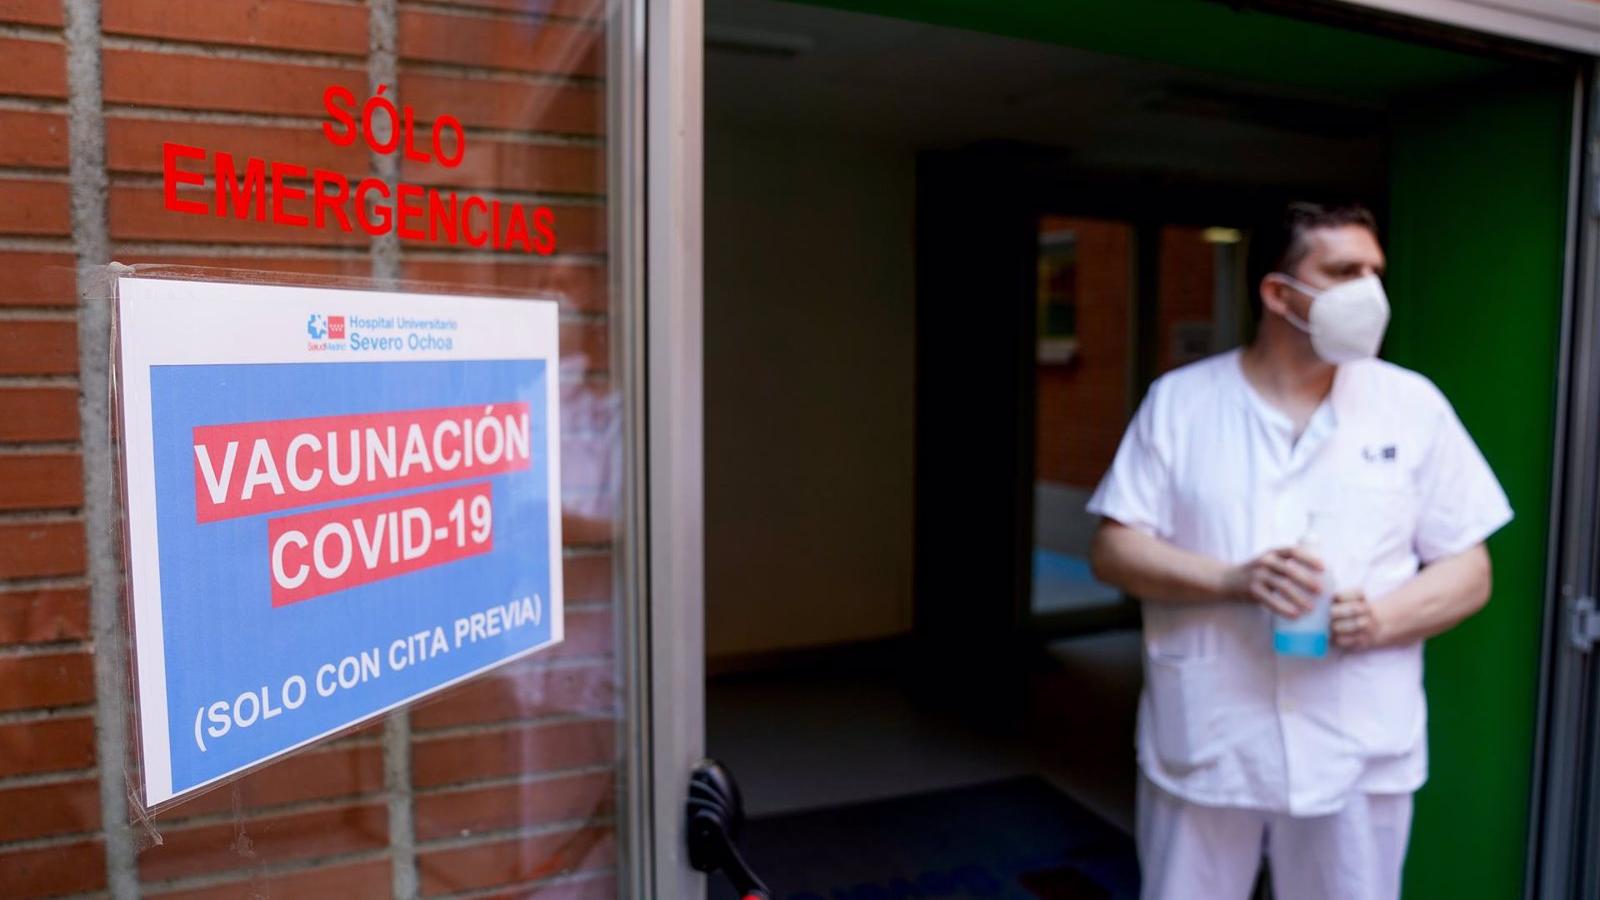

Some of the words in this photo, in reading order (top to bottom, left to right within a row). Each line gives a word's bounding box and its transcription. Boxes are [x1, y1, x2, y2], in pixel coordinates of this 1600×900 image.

[323, 85, 464, 168] SÓLO
[163, 142, 556, 255] EMERGENCIAS
[350, 315, 394, 330] Hospital
[397, 317, 458, 330] Universitario
[350, 333, 403, 350] Severo
[408, 333, 453, 350] Ochoa
[194, 406, 530, 504] VACUNACIÓN
[271, 495, 492, 589] COVID-19
[195, 676, 306, 751] (SOLO
[316, 648, 381, 697] CON
[388, 627, 449, 670] CITA
[455, 594, 541, 648] PREVIA)
